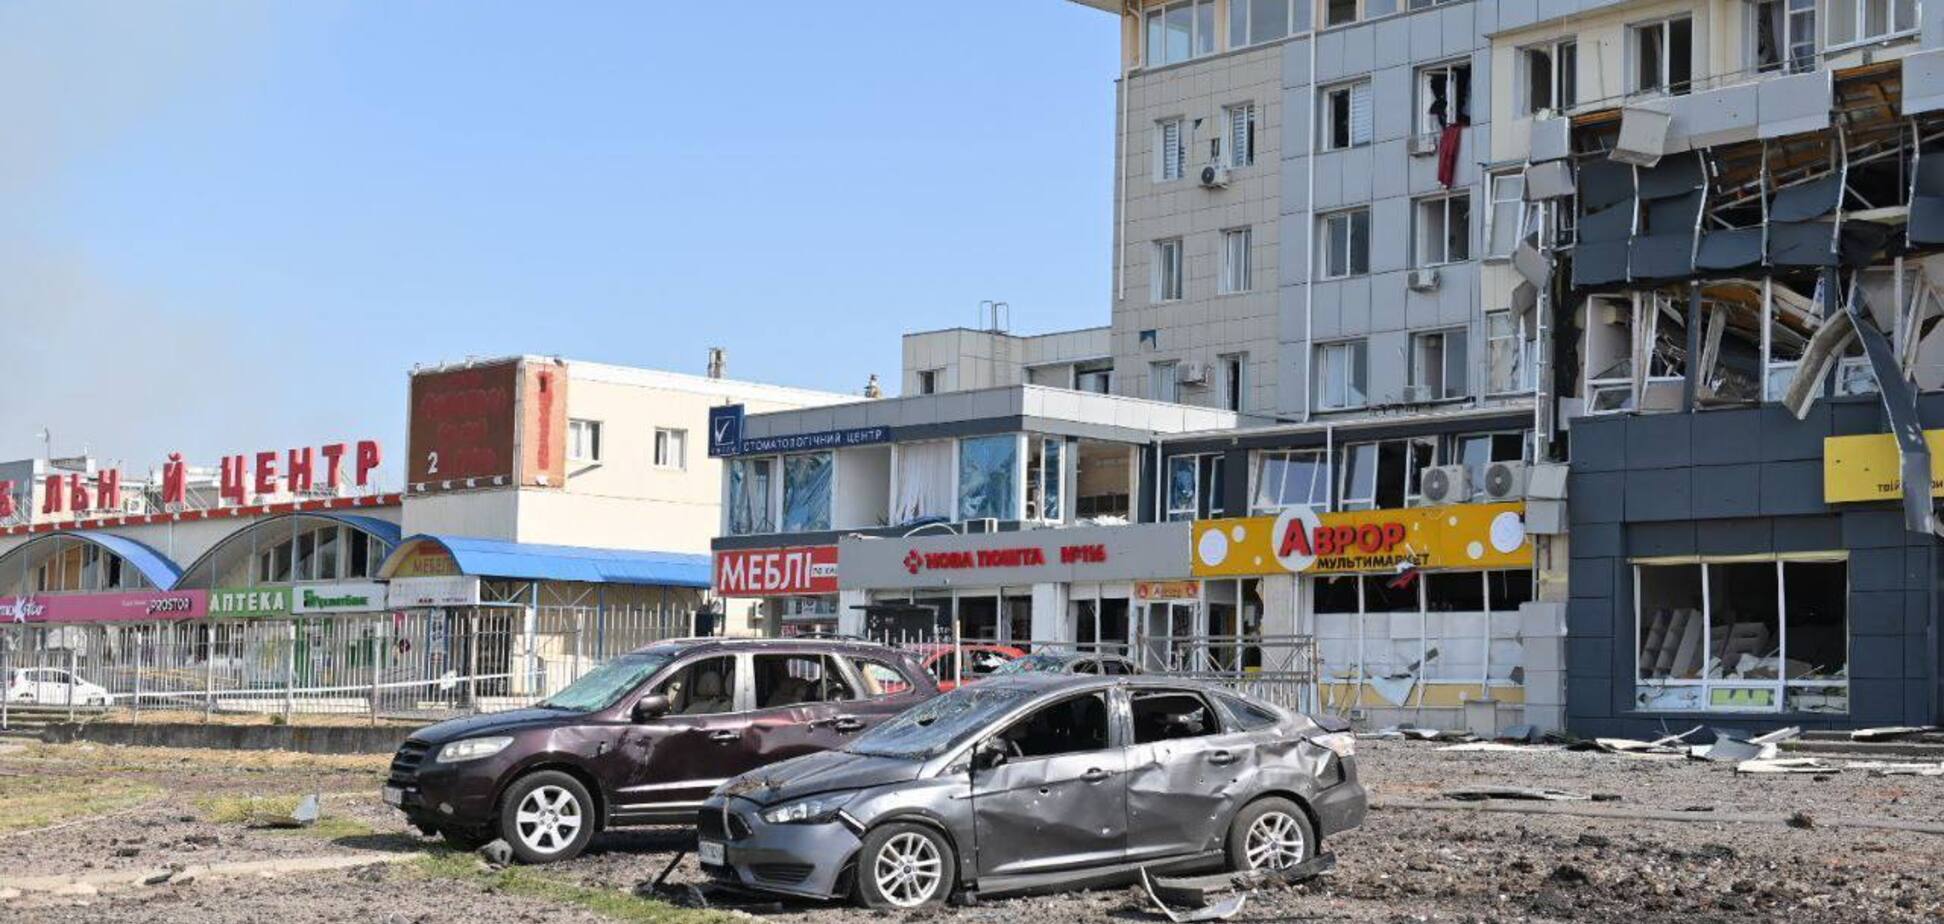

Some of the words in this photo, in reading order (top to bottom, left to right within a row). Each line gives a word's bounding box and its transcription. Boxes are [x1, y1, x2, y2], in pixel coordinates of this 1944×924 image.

[743, 432, 841, 452] СТОМАТОЛОГІЧНИЙ
[846, 429, 882, 444] ЦЕНТР
[219, 440, 382, 506] ЦЕНТР
[427, 451, 438, 475] 2
[924, 552, 974, 569] НОВА
[976, 548, 1046, 568] ПОШТА
[720, 552, 812, 591] МЕБЛІ
[150, 597, 191, 613] PROSTOR
[209, 591, 284, 612] АПТЕКА
